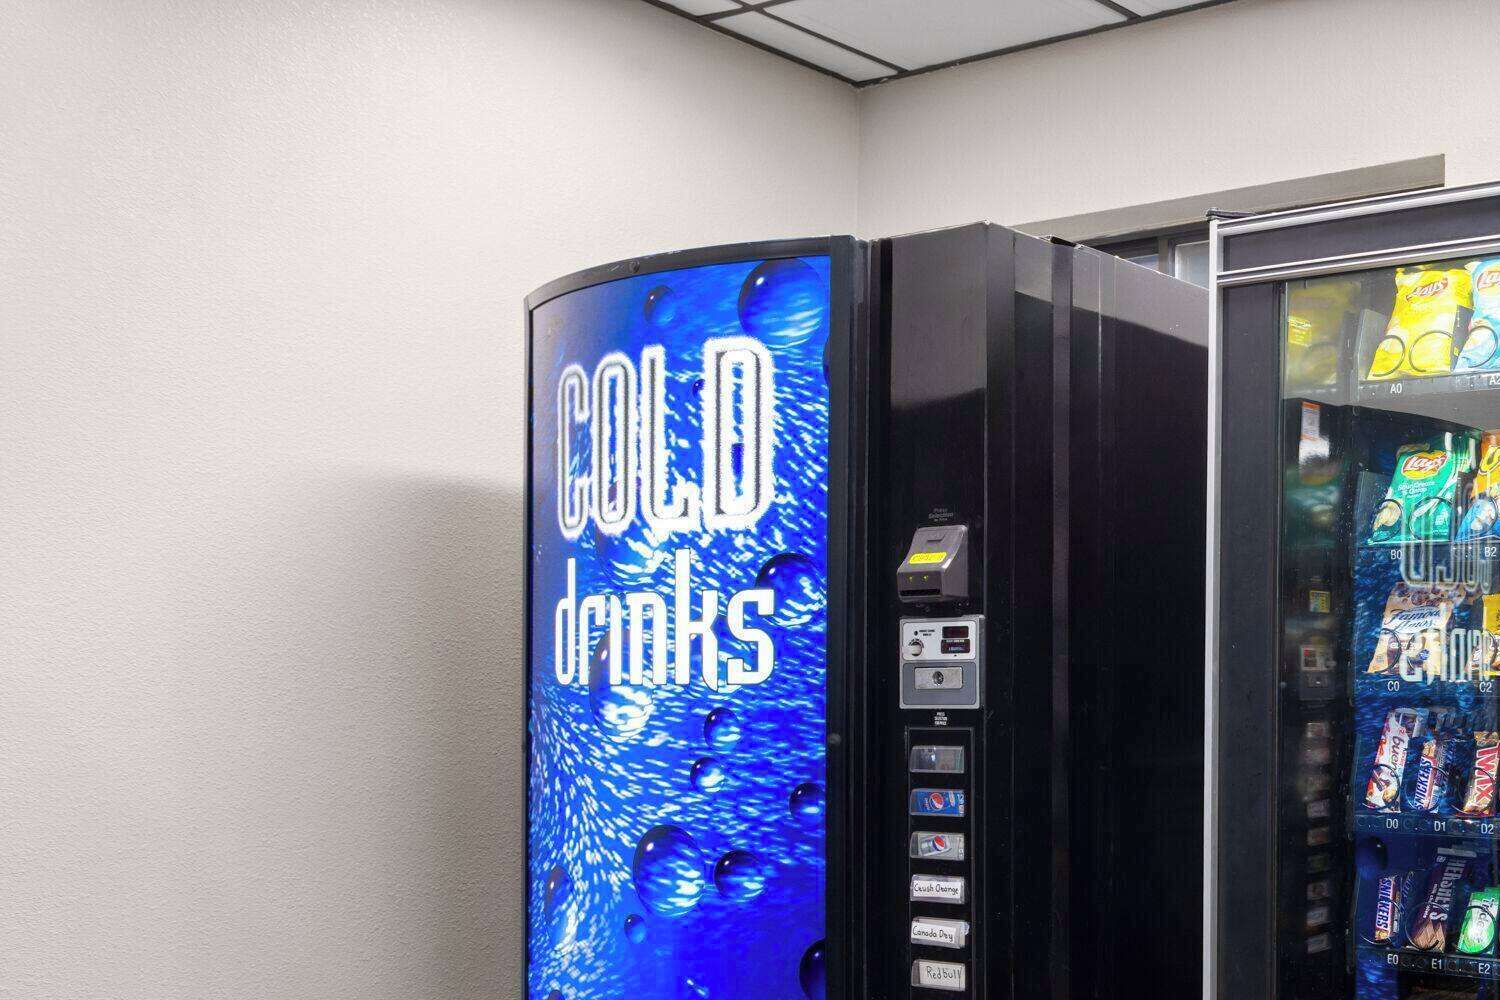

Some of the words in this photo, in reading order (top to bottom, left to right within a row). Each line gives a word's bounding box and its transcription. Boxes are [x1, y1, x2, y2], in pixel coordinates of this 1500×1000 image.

[1390, 383, 1403, 394] A0
[557, 335, 775, 539] COLD
[1390, 550, 1402, 560] B0
[1484, 547, 1497, 558] B2
[555, 547, 775, 690] drinks
[1387, 681, 1400, 692] C0
[1479, 682, 1492, 693] C2
[1413, 755, 1433, 810] SNICKERS
[1386, 818, 1399, 829] D0
[1433, 821, 1446, 832] D1
[1480, 823, 1494, 835] D2
[1375, 878, 1393, 930] SNICKERS
[912, 926, 937, 938] Canada
[939, 930, 954, 942] Dry
[1386, 953, 1399, 965] E0
[1431, 958, 1443, 970] E1
[1478, 963, 1491, 975] E2
